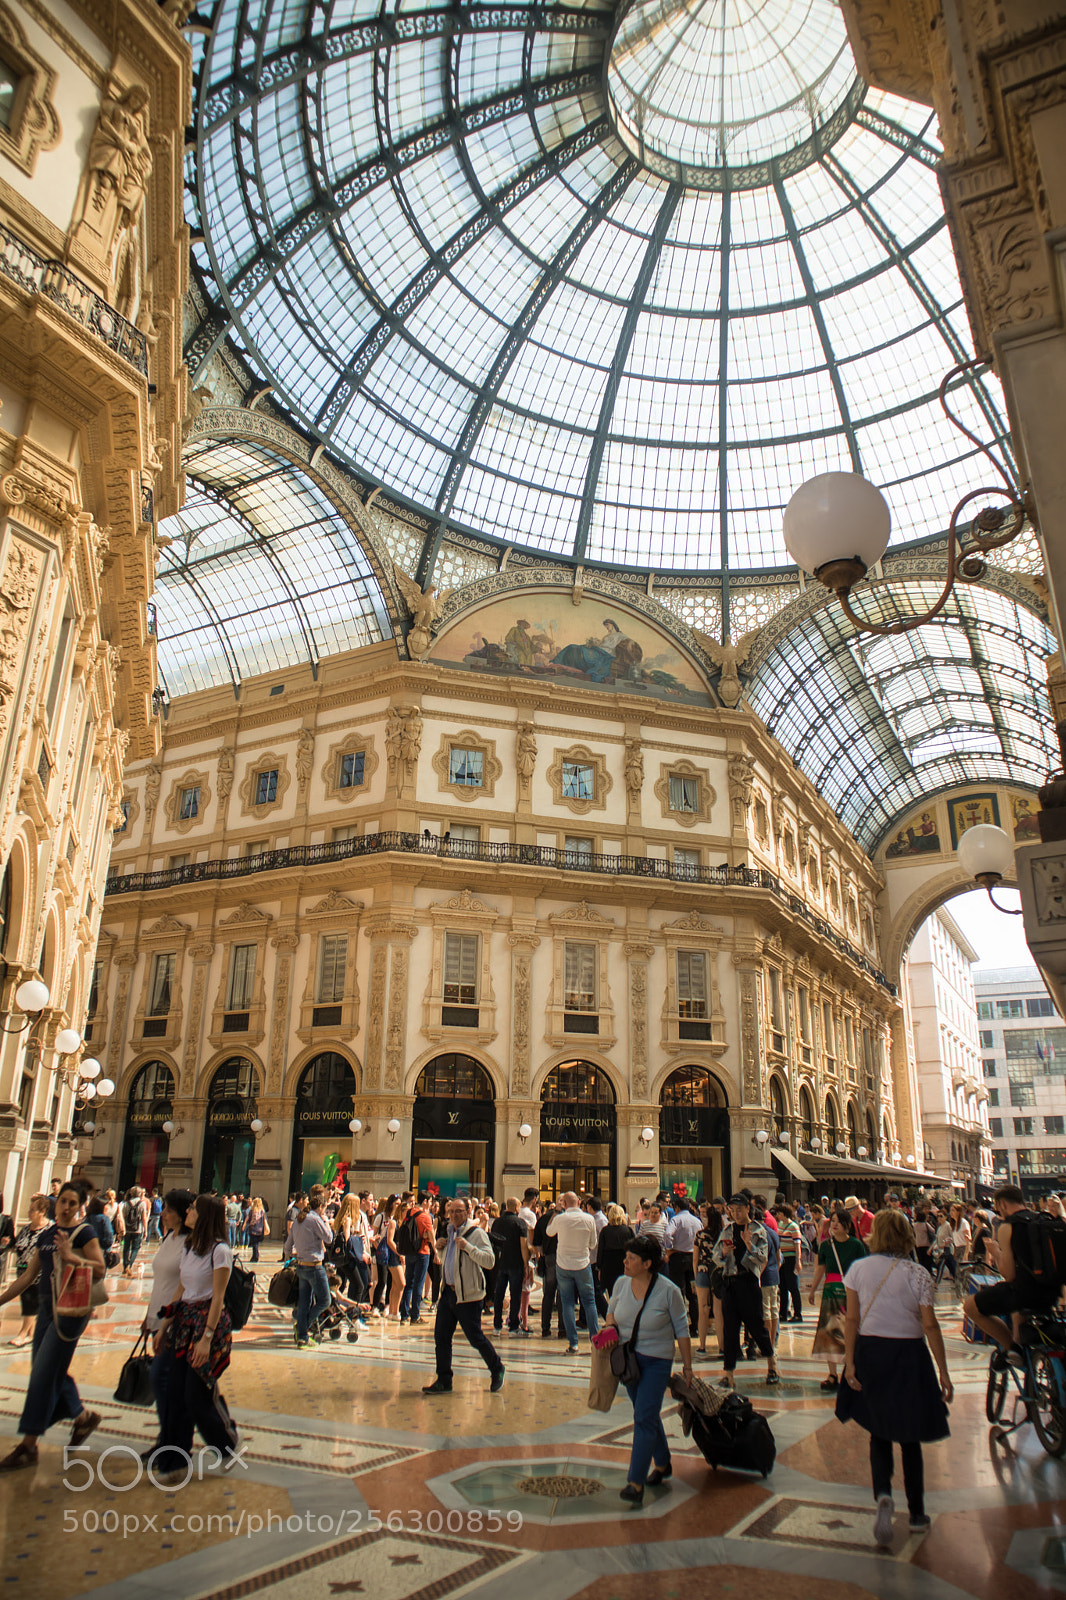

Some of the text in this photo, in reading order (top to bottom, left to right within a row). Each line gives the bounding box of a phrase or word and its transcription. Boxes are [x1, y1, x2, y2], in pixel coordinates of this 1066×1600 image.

[299, 1111, 354, 1121] LOUIS VUITTON
[545, 1116, 609, 1128] LOUIS VUITTON
